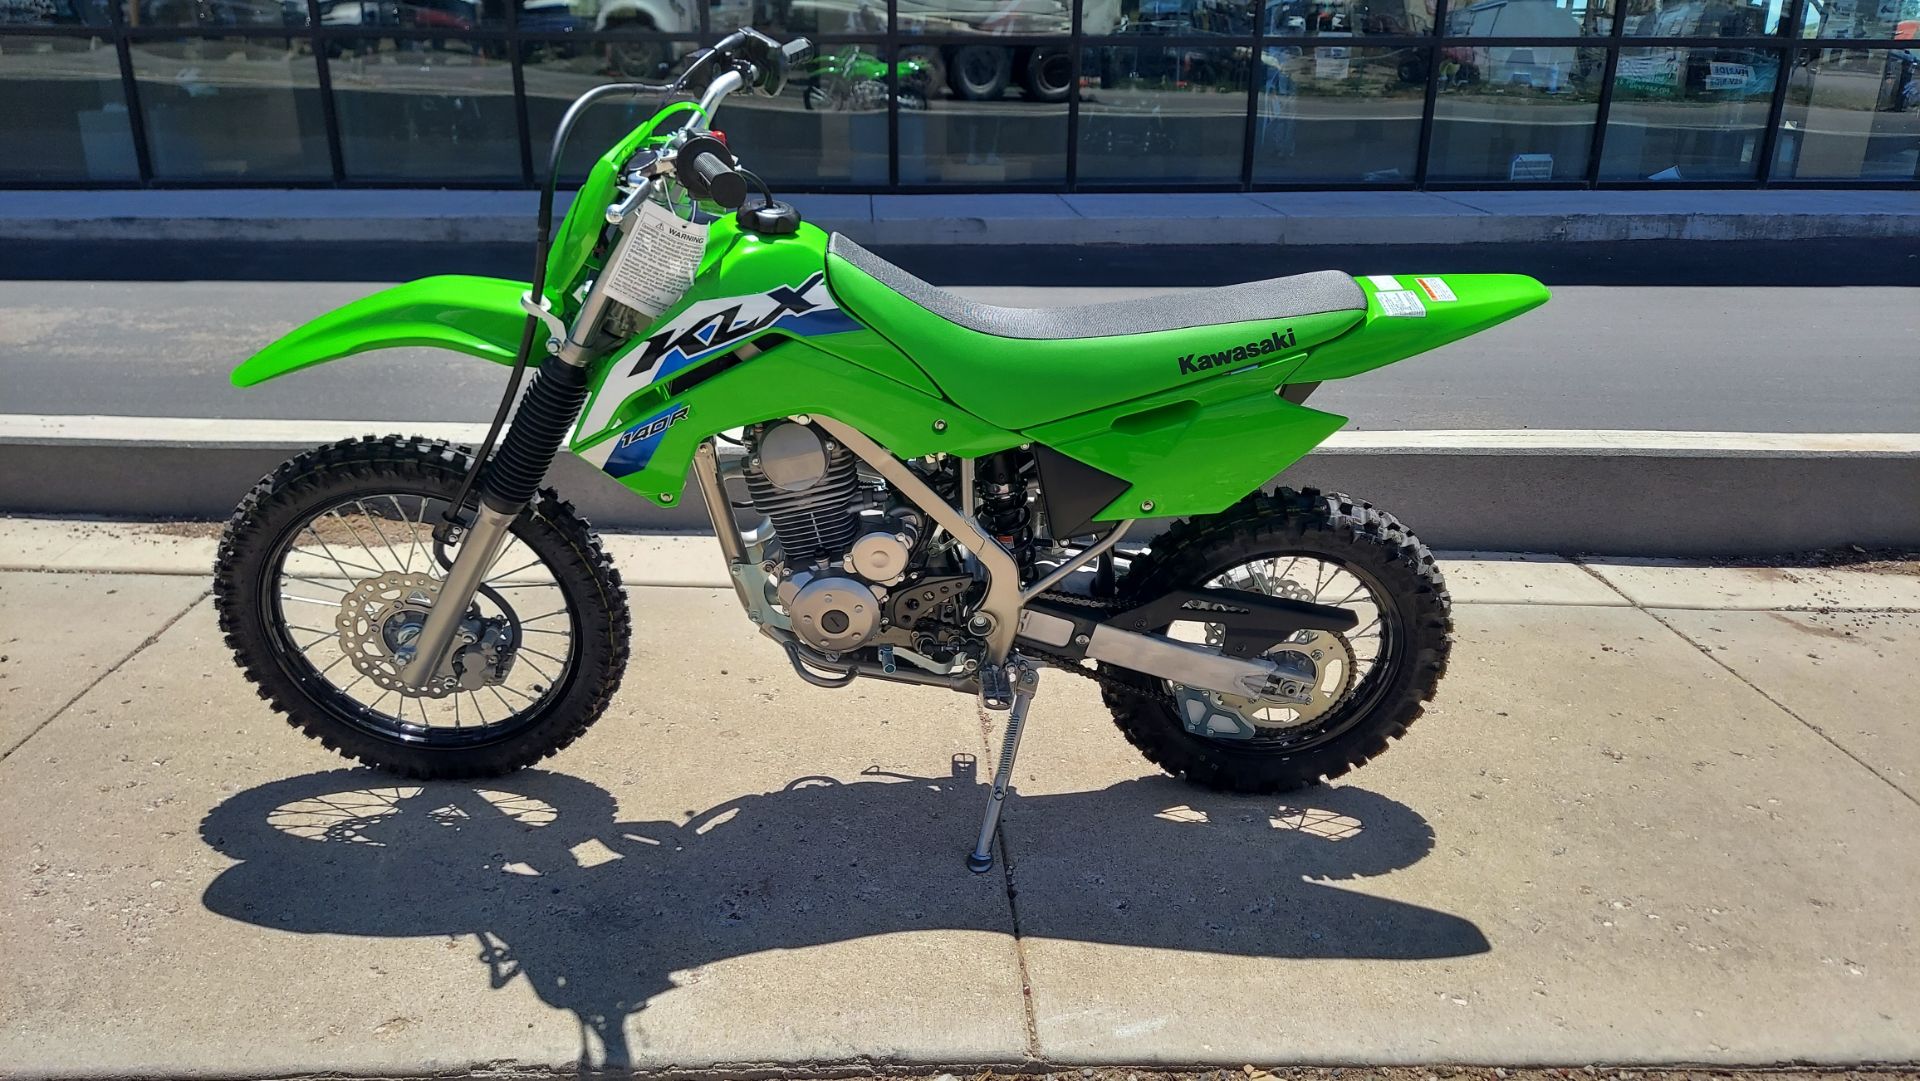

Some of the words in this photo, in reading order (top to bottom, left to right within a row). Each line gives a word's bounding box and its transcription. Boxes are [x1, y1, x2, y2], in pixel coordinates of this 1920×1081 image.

[668, 226, 704, 245] WARNING
[628, 271, 824, 377] KLX
[1178, 327, 1297, 375] Kawasaki
[620, 405, 691, 448] 140R
